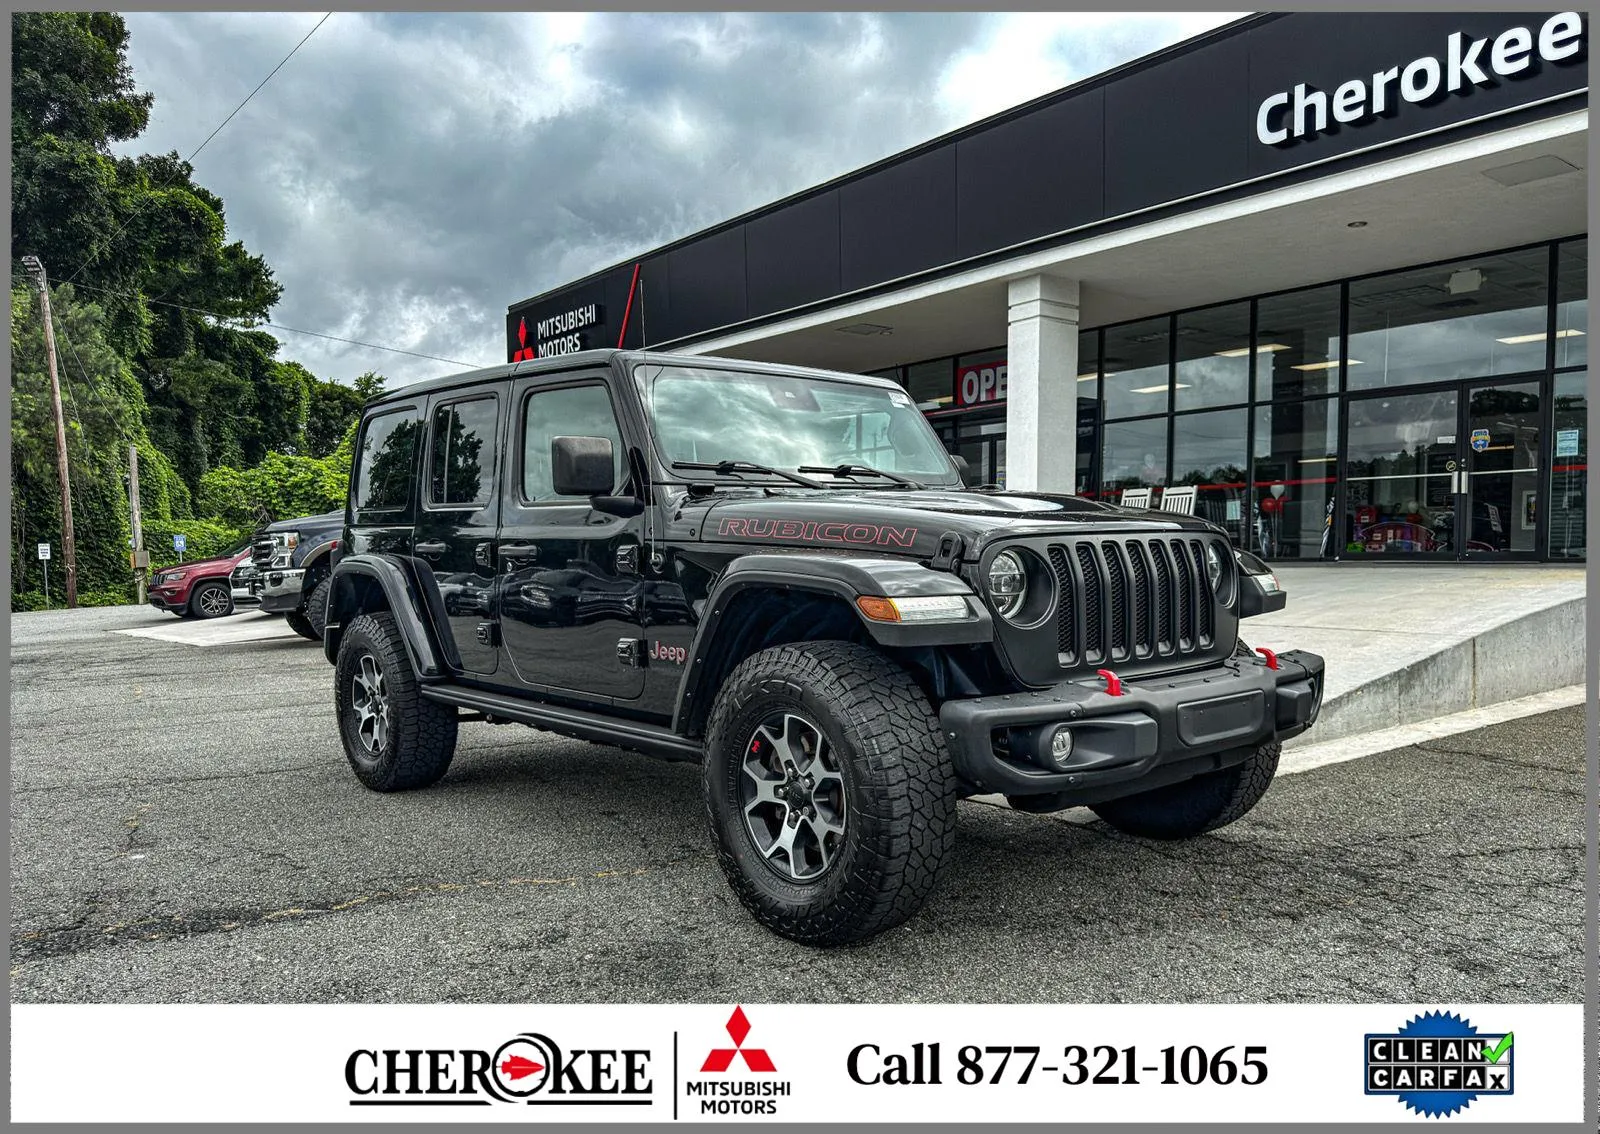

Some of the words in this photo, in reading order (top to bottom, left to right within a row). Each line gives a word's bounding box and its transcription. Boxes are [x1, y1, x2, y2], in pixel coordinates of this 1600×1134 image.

[1256, 11, 1582, 145] Cherokee
[537, 303, 596, 340] MITSUBISHI
[538, 333, 581, 359] MOTORS
[718, 517, 918, 547] RUBICON
[651, 640, 687, 665] Jeep
